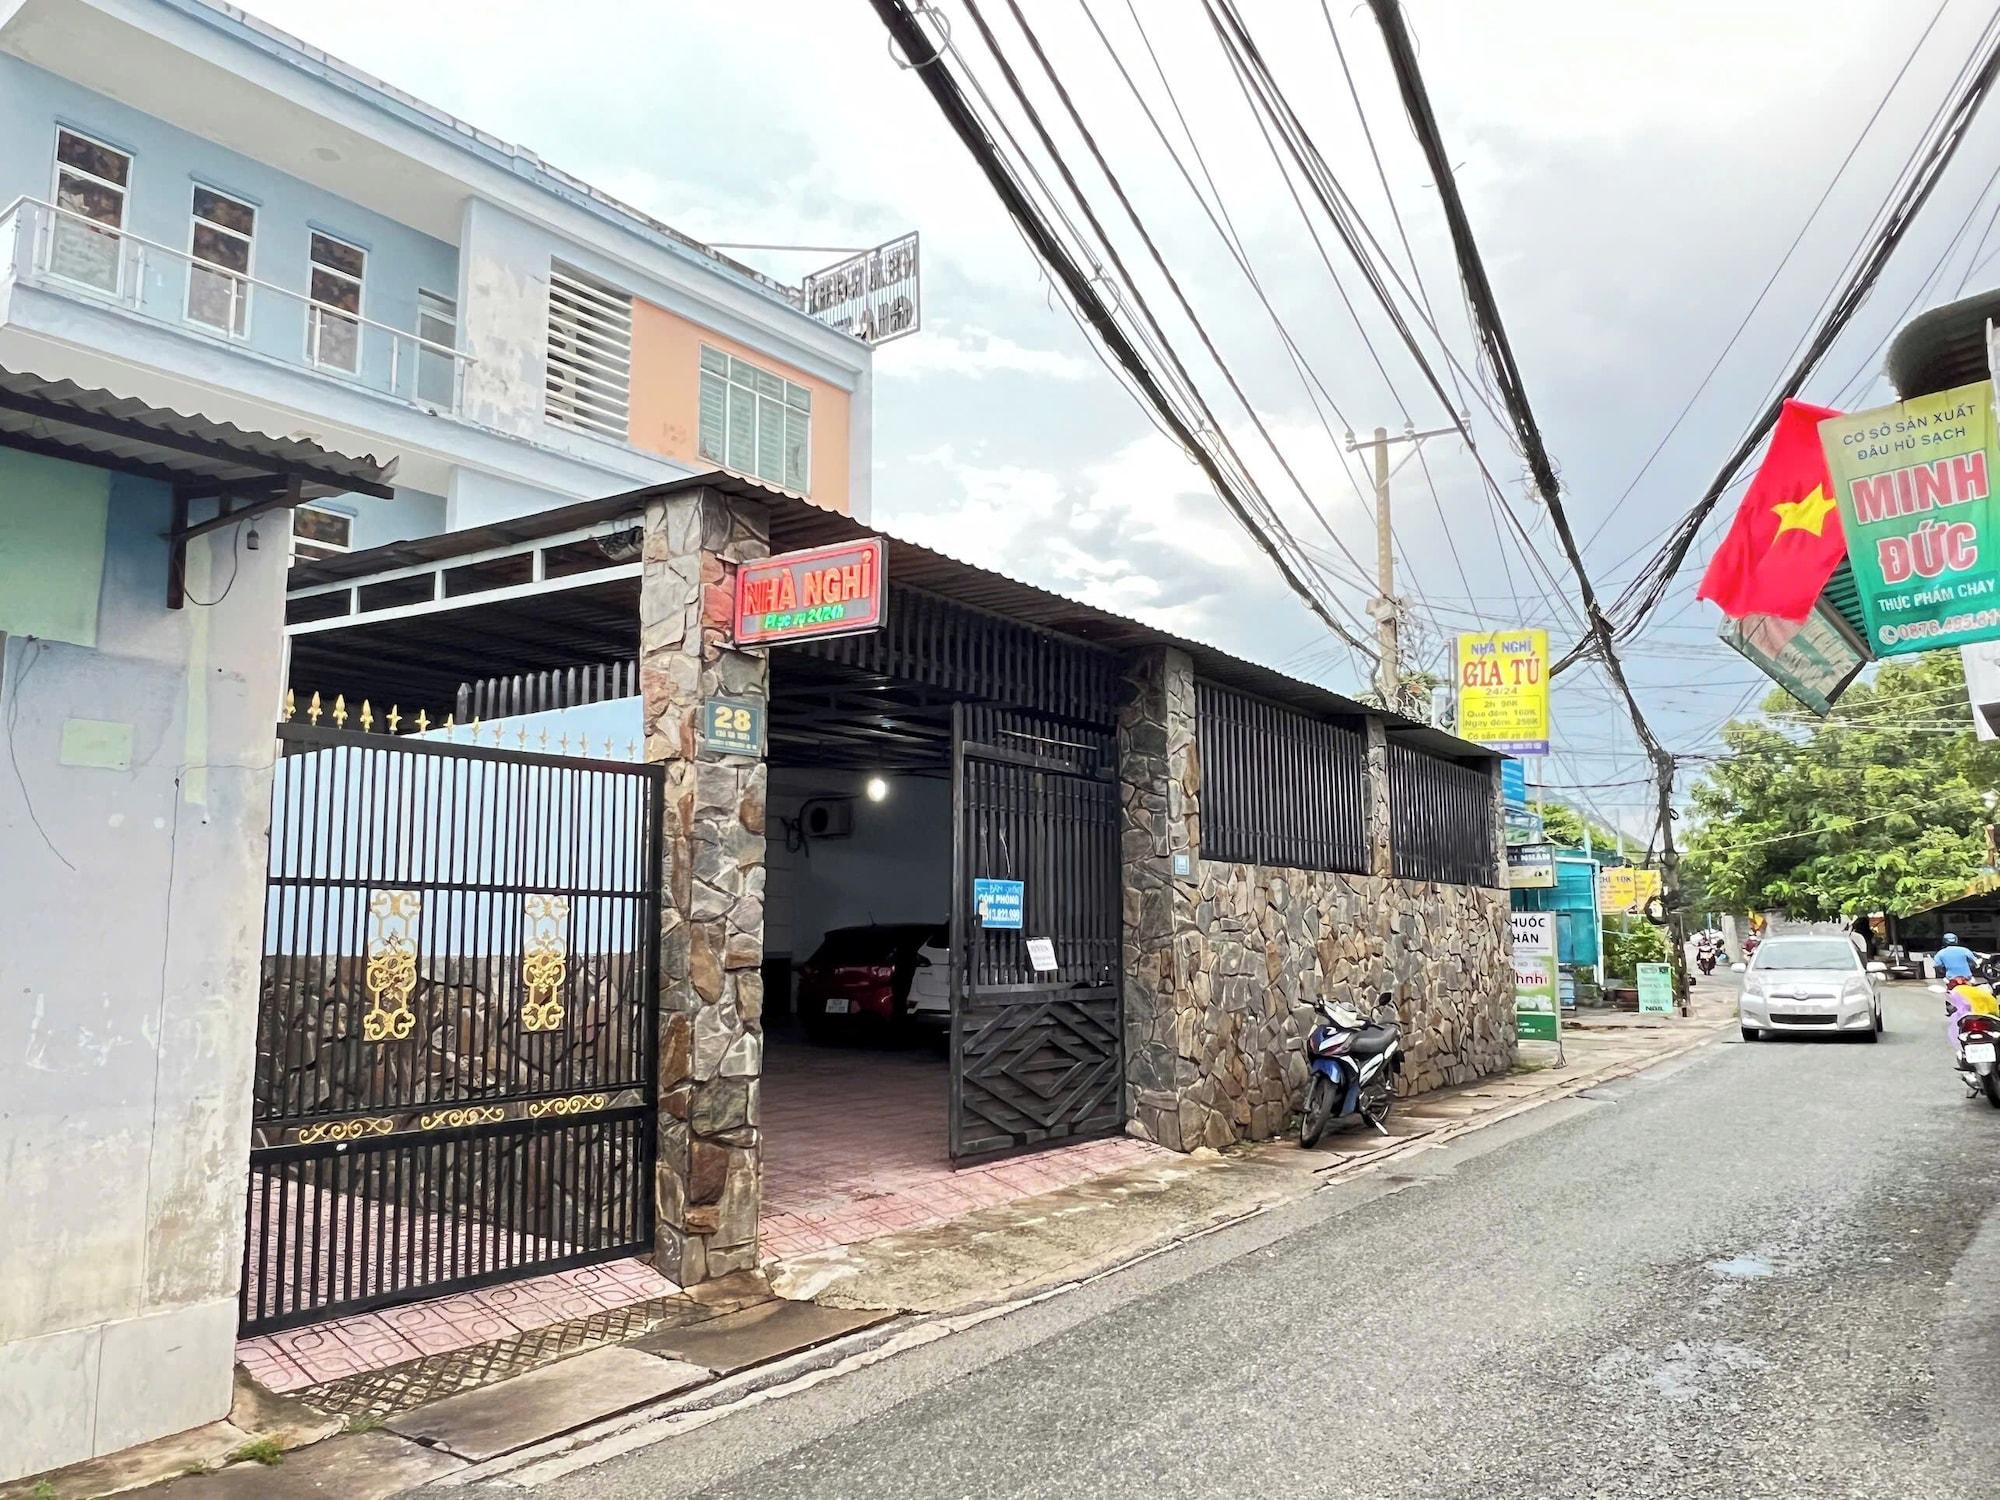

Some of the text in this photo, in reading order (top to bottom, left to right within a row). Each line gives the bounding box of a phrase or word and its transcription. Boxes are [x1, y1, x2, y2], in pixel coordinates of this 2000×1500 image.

[1933, 403, 1976, 424] XUẤT
[1921, 426, 1966, 446] SẠCH
[1849, 451, 1989, 526] MINH
[1877, 520, 1978, 585] ĐỨC
[742, 550, 873, 616] NHÀ NGHỈ
[1957, 578, 1995, 598] CHAY
[1510, 651, 1540, 685] TÚ
[715, 706, 751, 731] 28
[1511, 915, 1545, 928] HUỐC
[1512, 931, 1539, 944] HÂN
